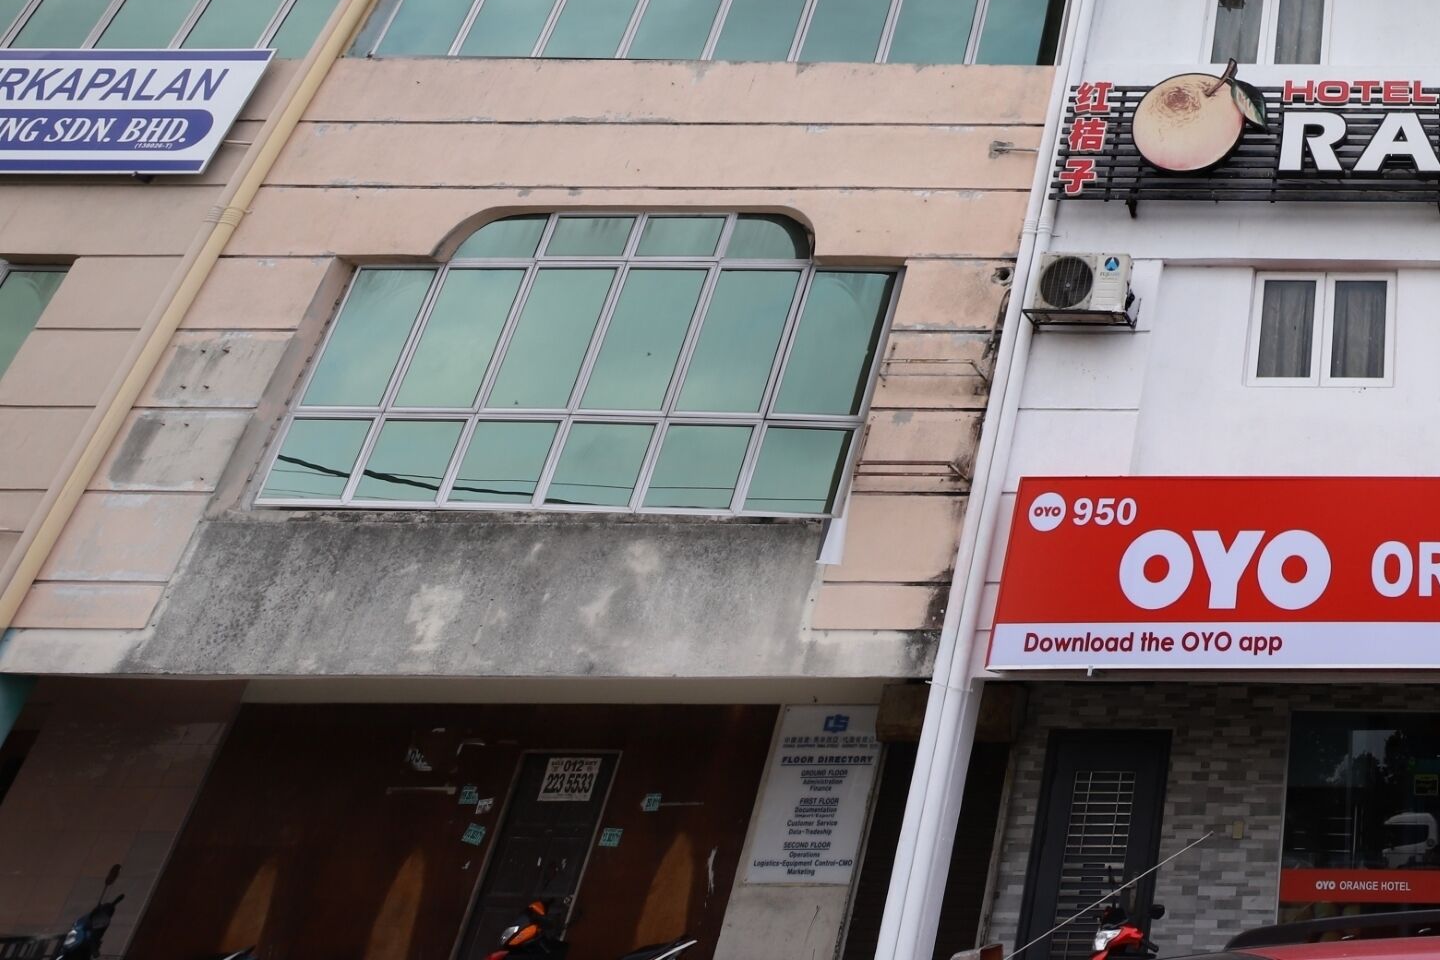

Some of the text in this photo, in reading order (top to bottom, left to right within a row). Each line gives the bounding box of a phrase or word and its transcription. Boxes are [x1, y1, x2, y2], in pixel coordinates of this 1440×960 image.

[0, 67, 230, 101] RKAPALAN
[1282, 79, 1438, 105] HOTEL
[43, 117, 118, 142] SDN.
[117, 117, 190, 143] BHD.
[1034, 506, 1061, 518] OYO
[1072, 497, 1138, 526] 950
[1119, 528, 1333, 610] OYO
[1024, 631, 1283, 656] Download the OYO app
[563, 759, 584, 772] 012
[782, 756, 873, 764] FLOOR DIRECTORY
[543, 773, 566, 794] 223
[818, 797, 839, 805] FLOOR
[787, 819, 814, 827] Customer
[789, 851, 820, 859] Operations
[787, 868, 816, 876] Marketing
[1315, 880, 1411, 891] OYO ORANGE HOTEL
